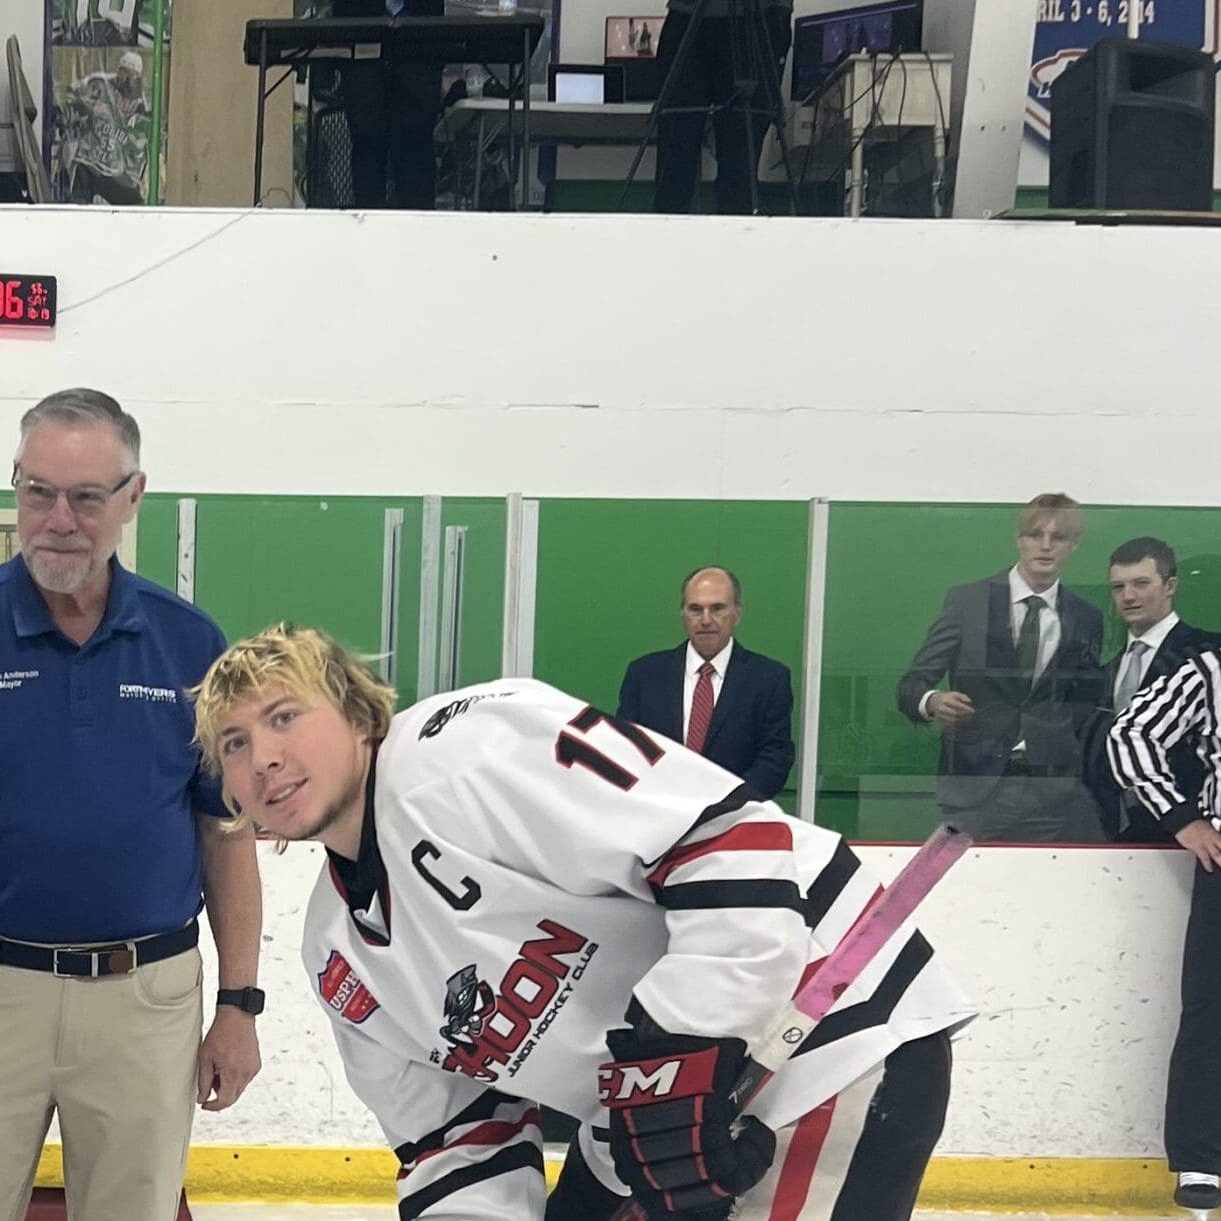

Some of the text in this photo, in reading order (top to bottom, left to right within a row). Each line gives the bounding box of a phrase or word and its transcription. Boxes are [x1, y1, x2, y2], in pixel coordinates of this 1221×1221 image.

[1070, 0, 1080, 22] 3
[1118, 0, 1156, 24] 214
[0, 679, 23, 690] Mayor
[3, 669, 39, 680] Anderson
[554, 704, 666, 793] 17
[411, 839, 483, 911] C
[507, 942, 600, 1078] JUNIOR HOCKEY CLUB
